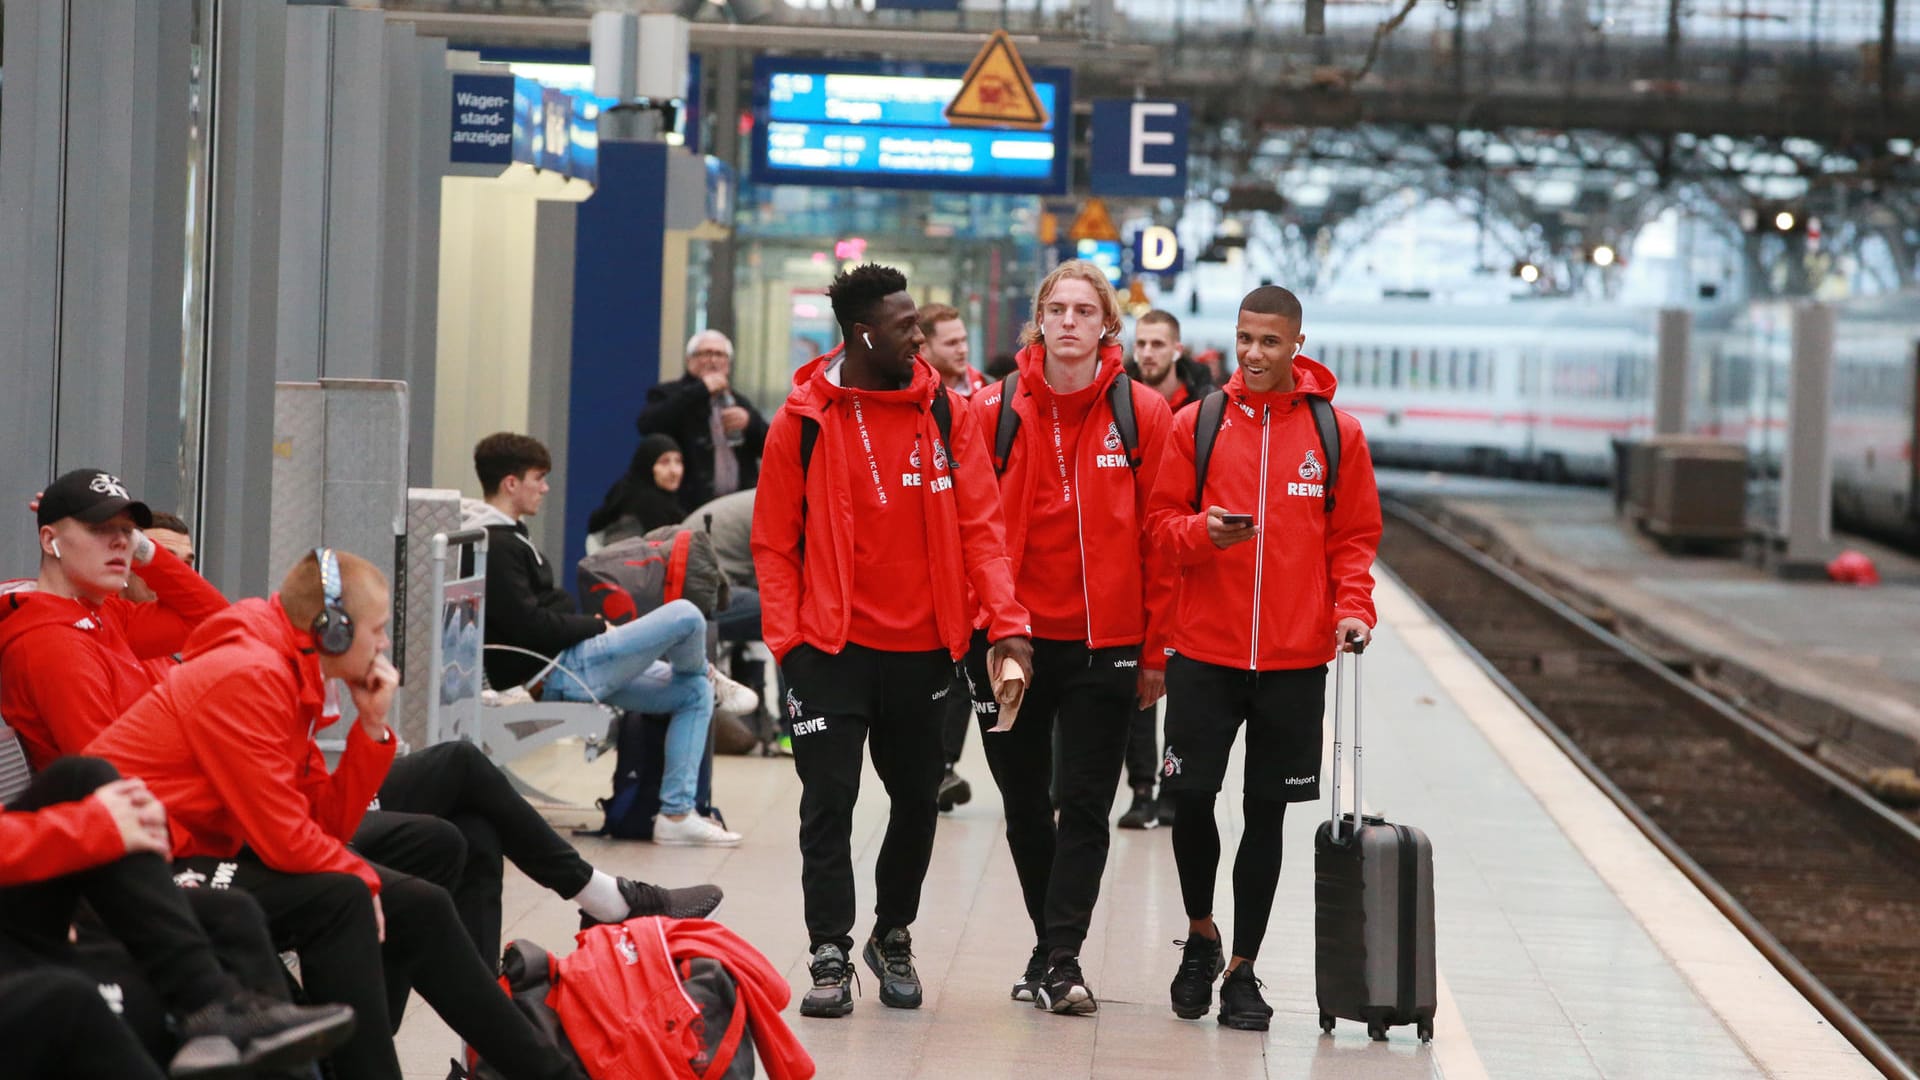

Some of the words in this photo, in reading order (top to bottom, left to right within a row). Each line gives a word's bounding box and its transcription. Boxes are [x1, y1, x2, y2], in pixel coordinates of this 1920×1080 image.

[456, 93, 509, 110] Wagen-
[460, 112, 504, 126] stand-
[453, 130, 511, 146] anzeiger
[1129, 103, 1177, 176] E
[1141, 225, 1178, 270] D
[1096, 454, 1129, 468] REW
[902, 473, 921, 487] RE
[930, 475, 952, 493] REW
[1287, 482, 1324, 498] REWE
[792, 717, 827, 737] REWE
[1285, 775, 1315, 786] uhlsport
